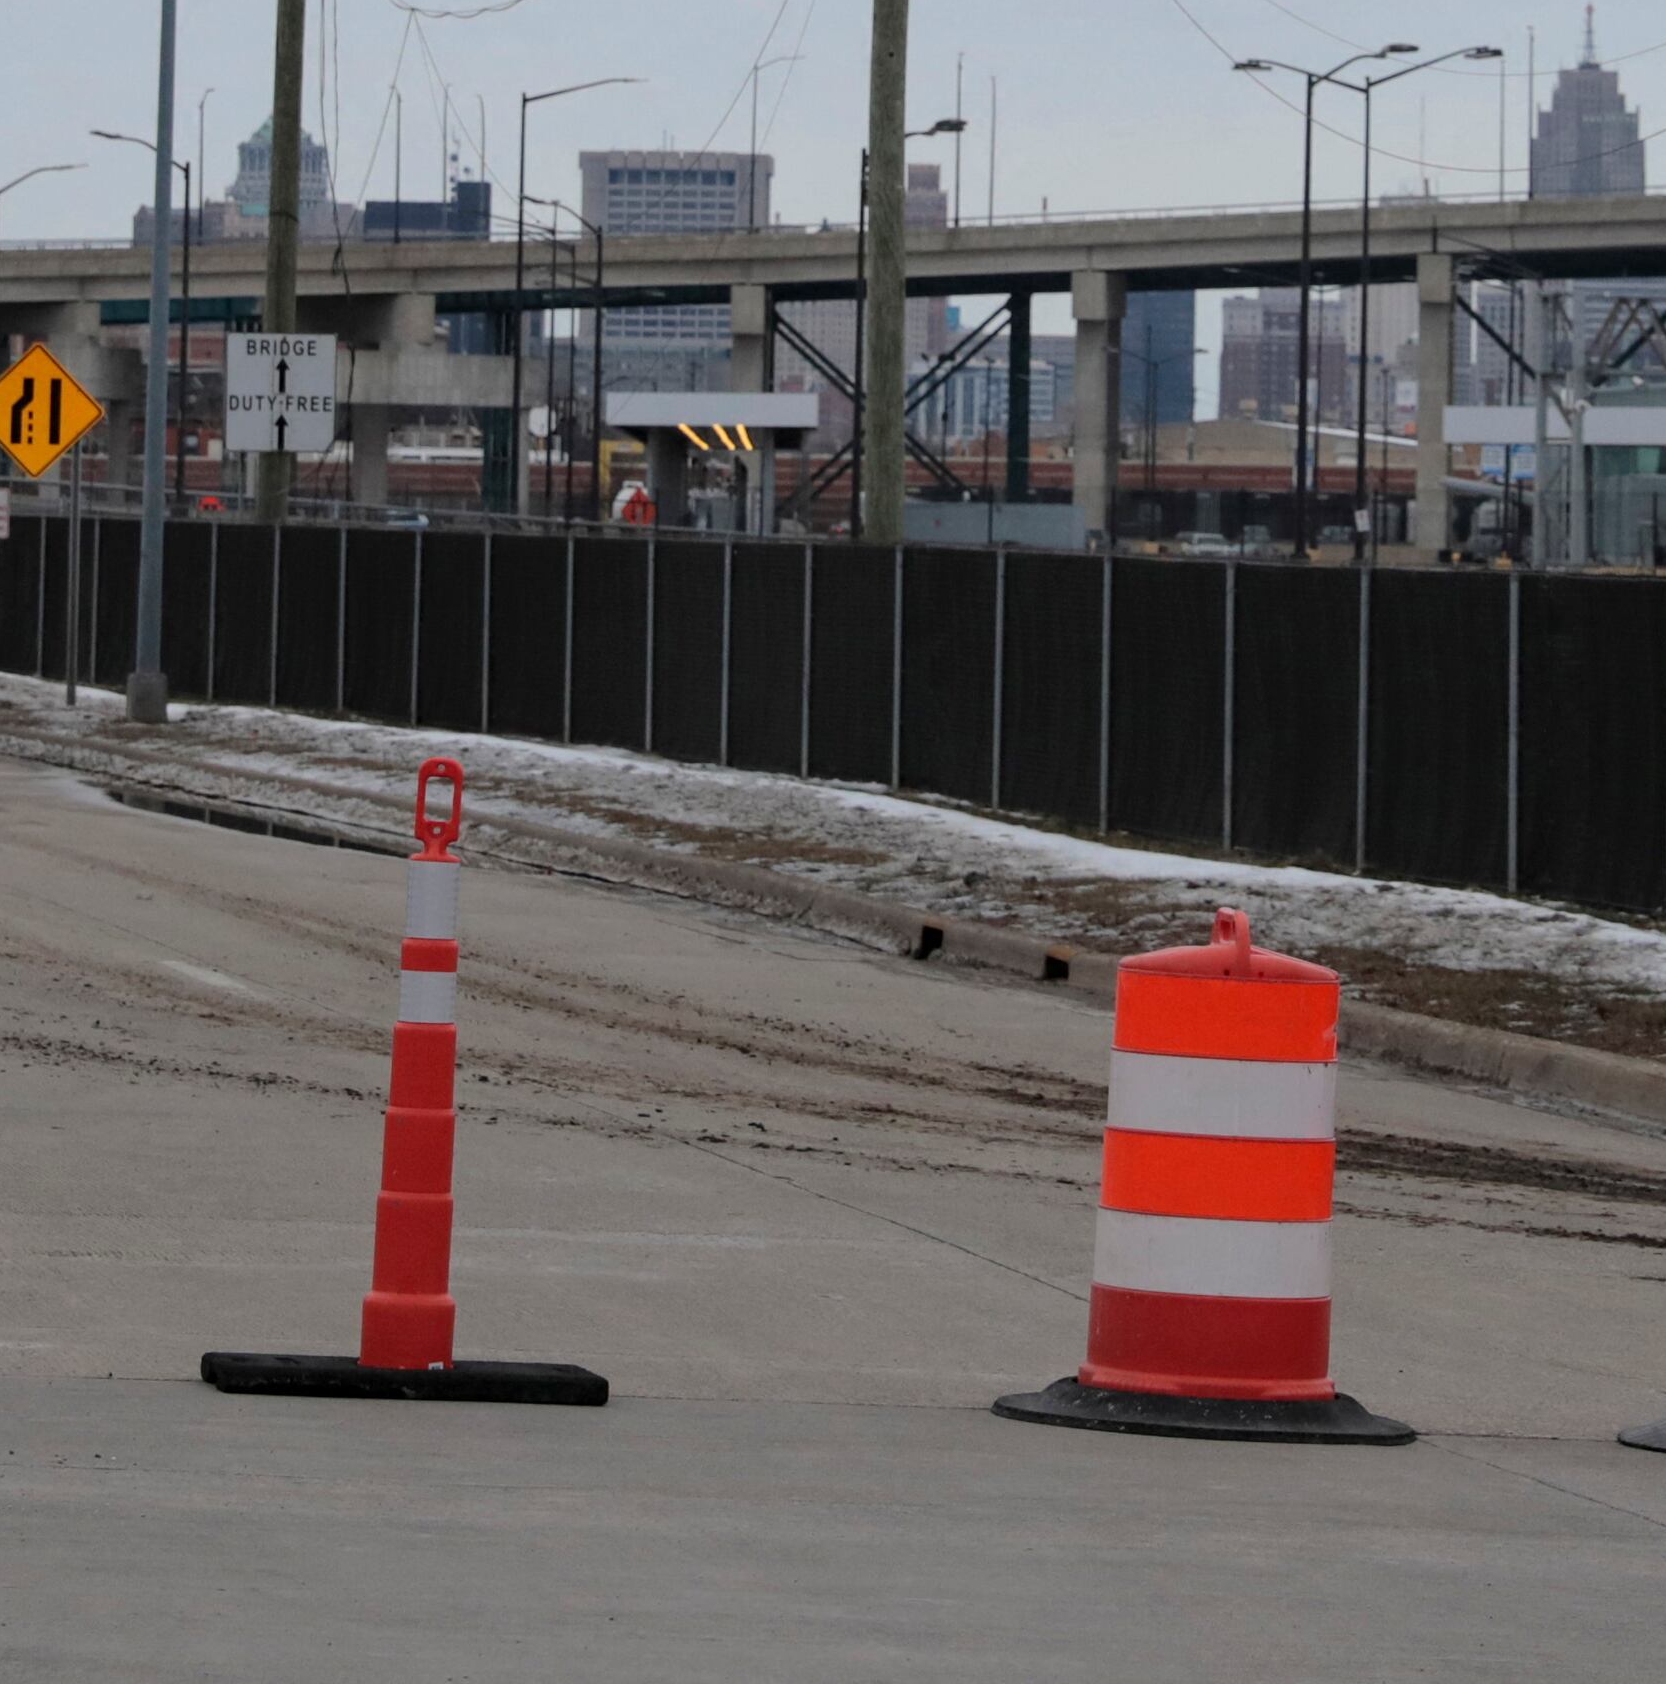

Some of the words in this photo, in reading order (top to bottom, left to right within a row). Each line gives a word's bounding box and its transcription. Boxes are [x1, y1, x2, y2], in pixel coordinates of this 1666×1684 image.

[246, 338, 318, 357] BRIDGE
[229, 394, 277, 412] DUTY
[285, 395, 333, 413] FREE
